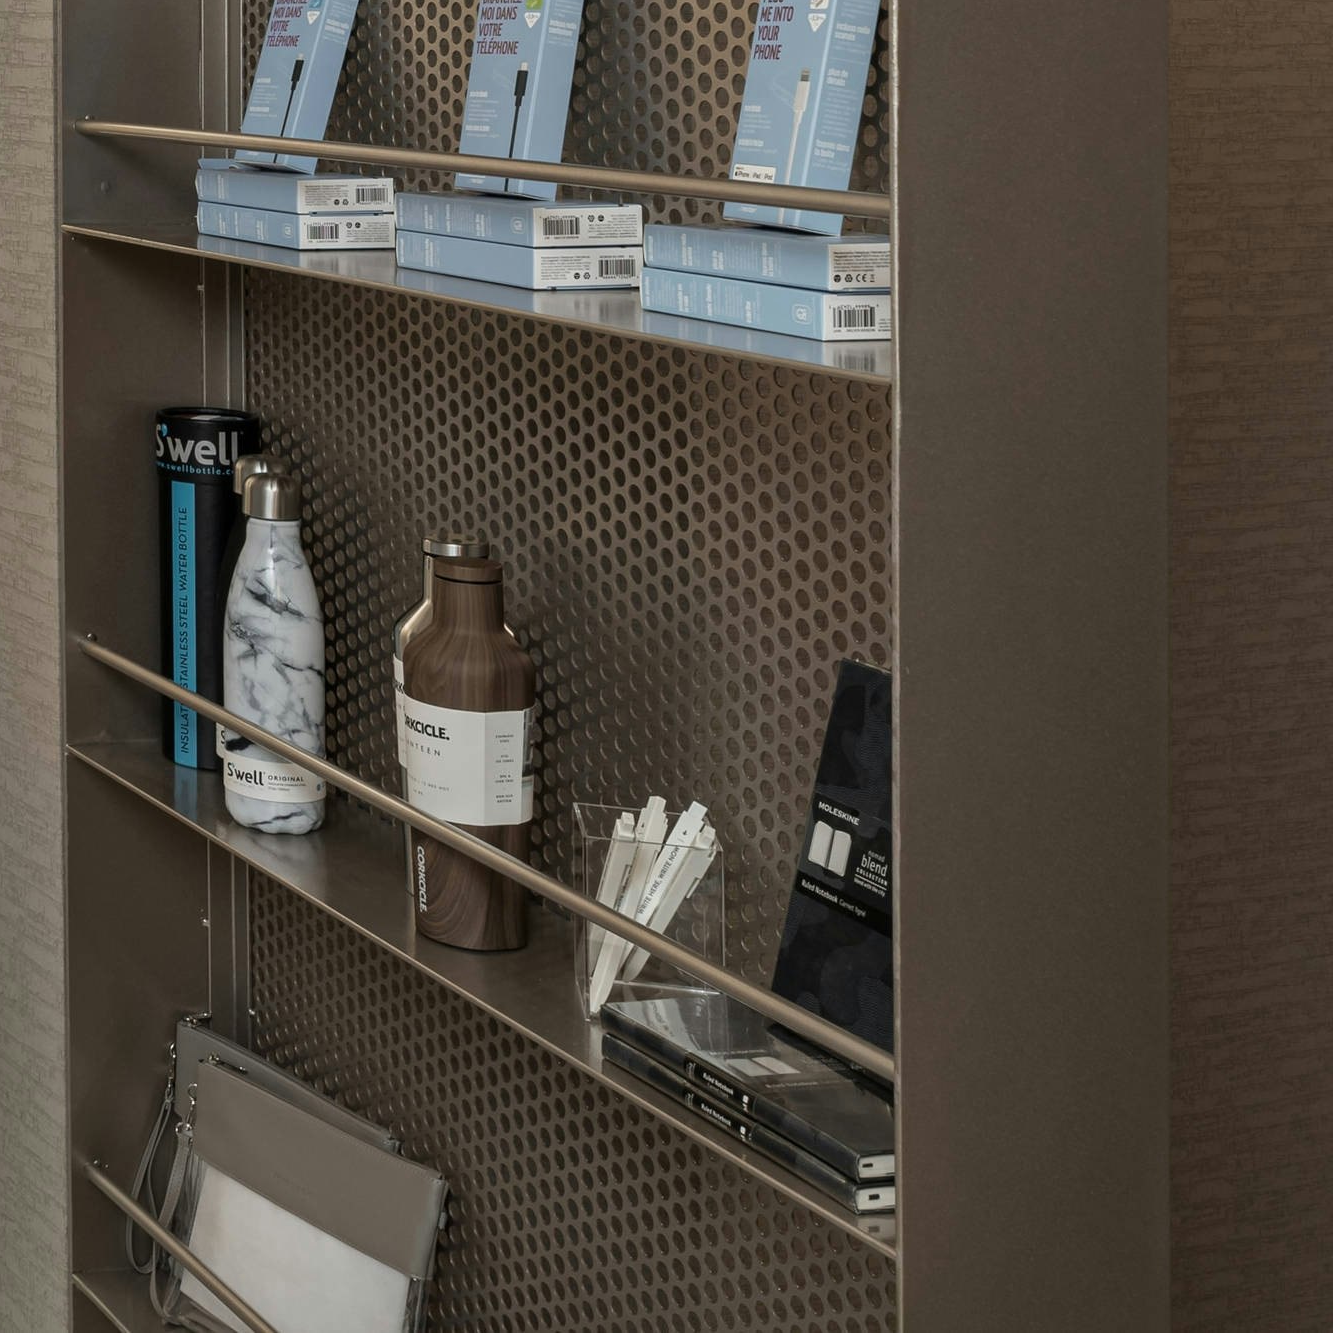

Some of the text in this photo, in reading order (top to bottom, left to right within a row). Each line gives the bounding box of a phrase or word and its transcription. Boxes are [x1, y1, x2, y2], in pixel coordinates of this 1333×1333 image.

[273, 6, 303, 18] MOI DANS
[481, 6, 518, 20] MOI DANS
[760, 6, 794, 22] ME INTO
[270, 20, 290, 33] VOTRE
[479, 22, 503, 37] VOTRE
[758, 25, 780, 42] YOUR
[476, 37, 519, 55] TÉLÉPHONE
[753, 43, 782, 60] PHONE
[178, 507, 190, 754] INSULAT STAINLESS STEEL WATER BOTTLE
[268, 774, 304, 783] ORIGINAL
[818, 801, 860, 826] MOLESKINE
[861, 854, 888, 877] blend
[856, 867, 888, 886] COLLECTION
[637, 898, 651, 914] WRITE
[659, 862, 673, 879] WRITE
[801, 878, 814, 892] Ruled
[814, 885, 838, 904] Notebook
